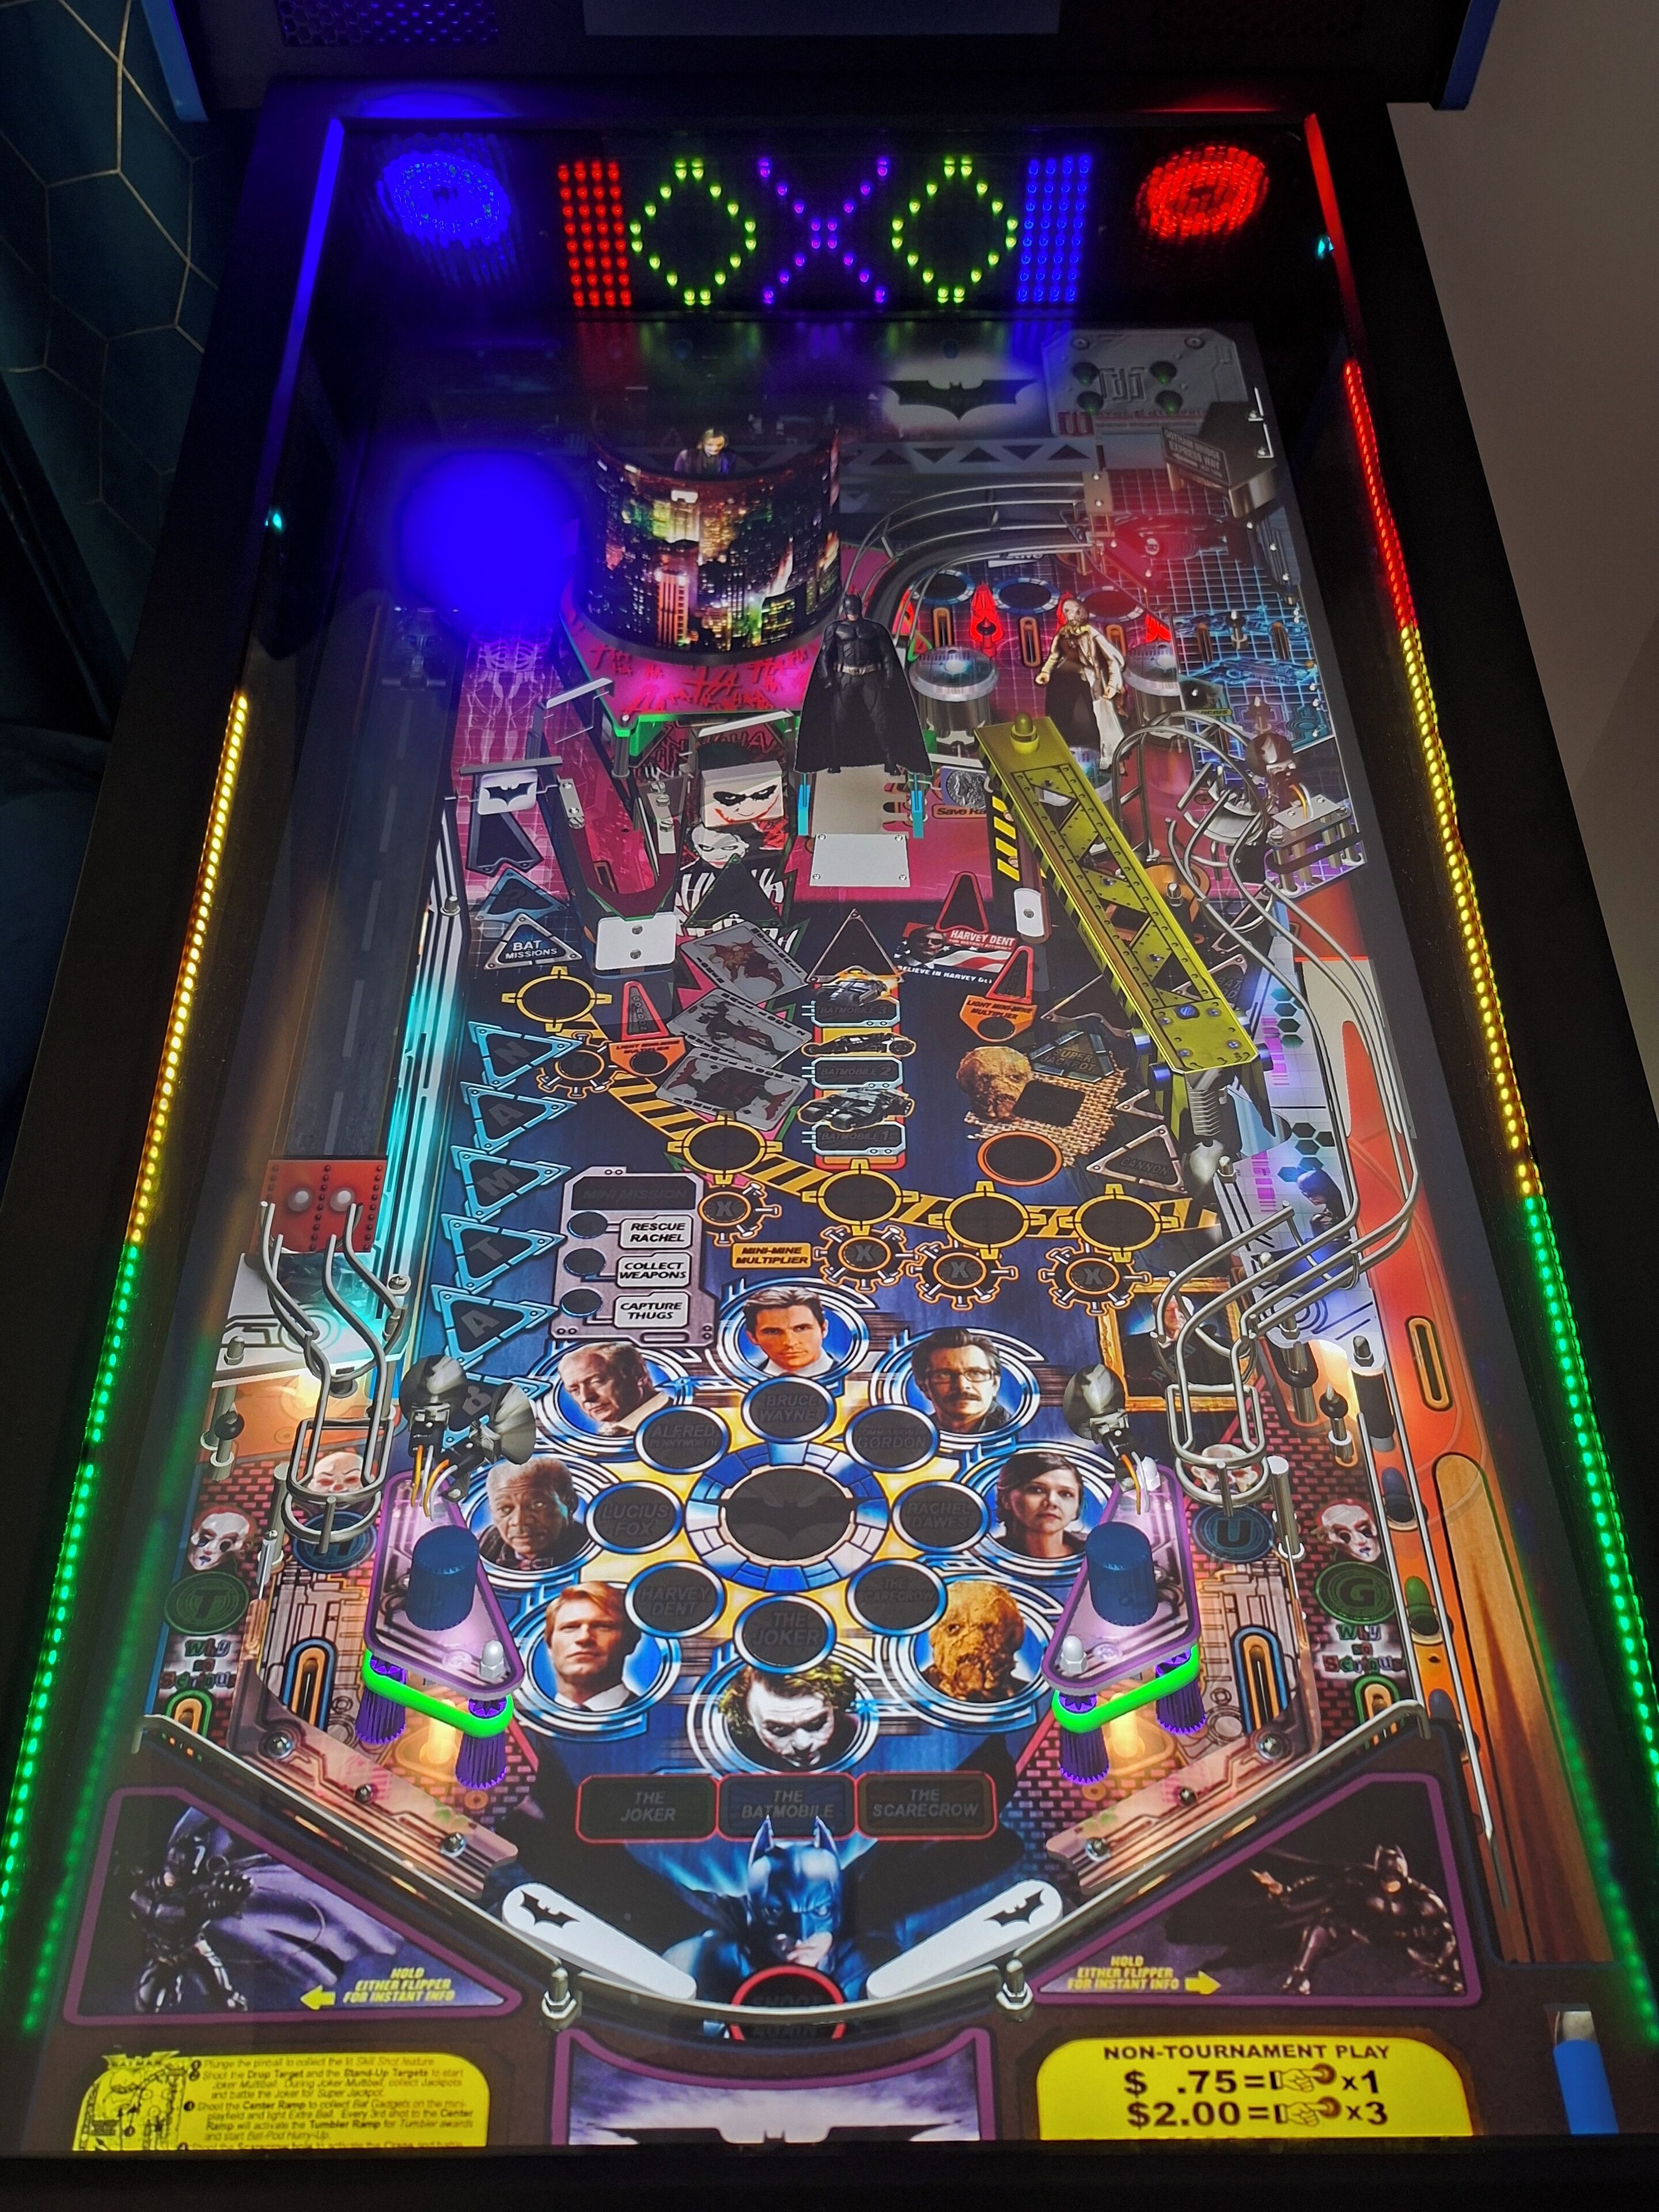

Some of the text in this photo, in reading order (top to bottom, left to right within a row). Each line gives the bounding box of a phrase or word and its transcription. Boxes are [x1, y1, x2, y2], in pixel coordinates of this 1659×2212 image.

[950, 930, 1016, 946] HARVEY DENT
[513, 940, 542, 951] BAT
[505, 948, 558, 959] MISSIONS
[943, 973, 976, 982] HARVEY
[878, 1006, 887, 1014] 3
[965, 999, 991, 1008] LIGHT
[632, 994, 647, 1031] GORDON
[971, 1009, 1019, 1020] MULTIPLIER
[700, 1052, 737, 1066] BALL
[1054, 1048, 1094, 1062] SUPER
[1040, 1055, 1094, 1071] JACKPOT
[820, 1066, 892, 1076] BATMOBILE 2
[881, 1131, 890, 1141] 1
[1121, 1157, 1169, 1176] CANNON
[630, 1222, 686, 1232] RESCUE
[630, 1233, 685, 1243] RACHEL
[741, 1247, 802, 1255] MINI-MINE
[624, 1262, 684, 1270] COLLECT
[735, 1256, 809, 1265] MULTIPLIER
[619, 1271, 687, 1279] WEAPONS
[620, 1302, 683, 1311] CAPTURE
[627, 1312, 674, 1320] THUGS
[766, 1394, 819, 1407] BRUCE
[760, 1410, 816, 1422] WAYNE
[652, 1423, 715, 1438] ALFRED
[857, 1436, 926, 1449] GORDON
[602, 1504, 670, 1519] LUCIUS
[907, 1502, 970, 1515] RACHEL
[614, 1521, 654, 1536] FOX
[911, 1517, 971, 1530] DAWES
[640, 1586, 709, 1601] HARVEY
[652, 1601, 696, 1615] DENT
[773, 1612, 806, 1628] THE
[752, 1629, 821, 1646] JOKER
[635, 1791, 665, 1805] THE
[772, 1790, 804, 1804] THE
[910, 1788, 940, 1802] THE
[620, 1808, 676, 1823] JOKER
[741, 1803, 835, 1819] BATMOBILE
[872, 1802, 979, 1818] SCARECROW
[1111, 1955, 1144, 1967] HOLD
[391, 1967, 425, 1979] HOLD
[1077, 1967, 1173, 1979] EITHER FLIPPER
[355, 1978, 451, 1991] EITHER FLIPPER
[1067, 1978, 1179, 1990] FOR INSTANT INFO
[343, 1990, 456, 2003] FOR INSTANT INFO
[1104, 2044, 1390, 2060] NON-TOURNAMENT PLAY
[247, 2070, 271, 2079] Drop
[275, 2069, 303, 2081] Target
[392, 2068, 428, 2078] Targets
[242, 2101, 275, 2109] Center
[278, 2100, 306, 2110] Ramp
[441, 2108, 473, 2117] Center
[352, 2120, 381, 2129] Ramp
